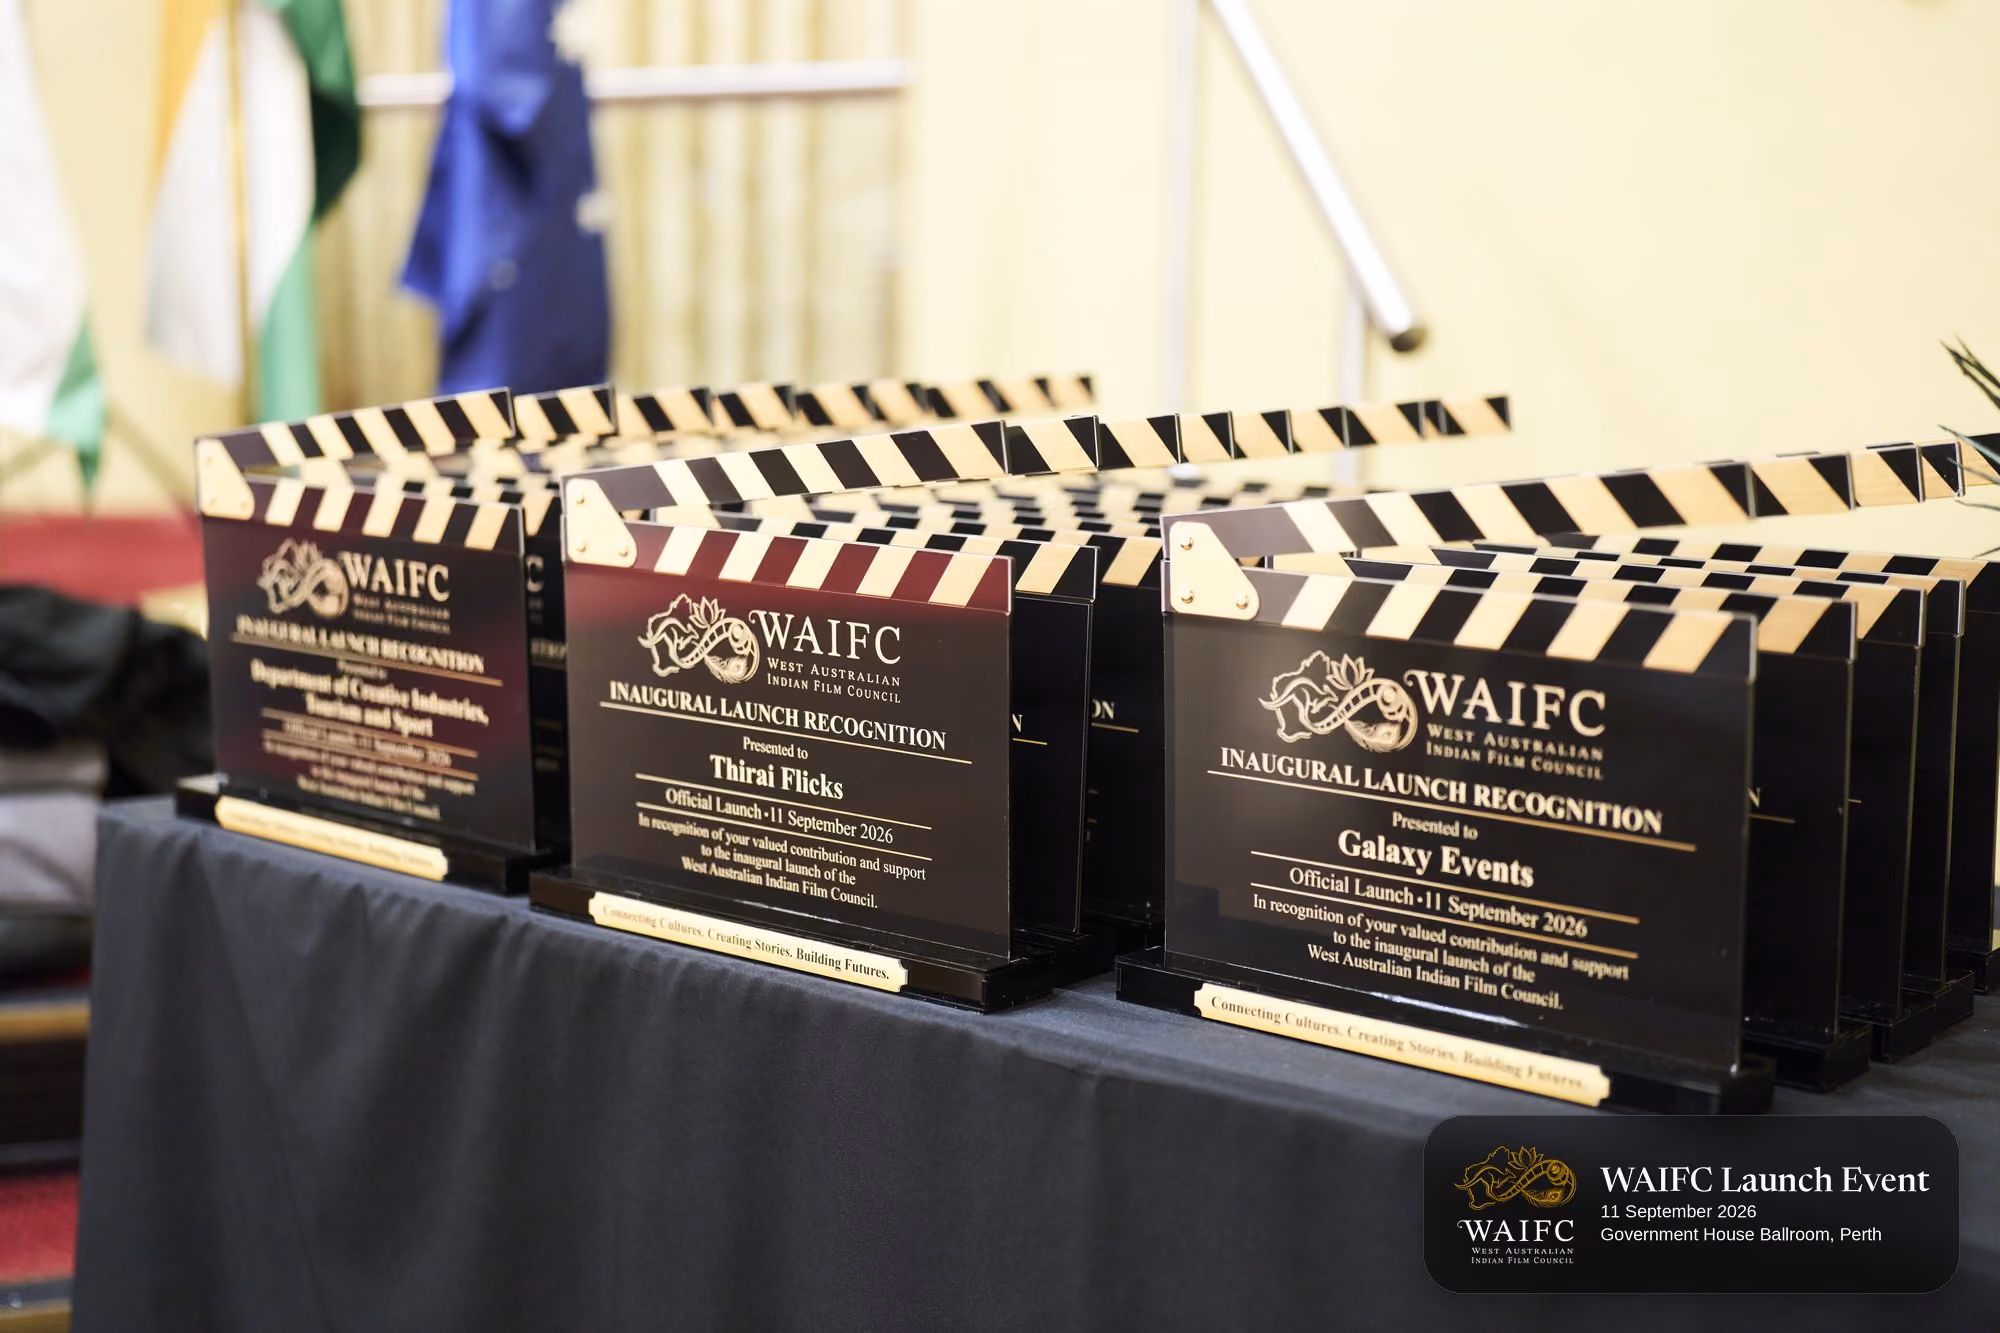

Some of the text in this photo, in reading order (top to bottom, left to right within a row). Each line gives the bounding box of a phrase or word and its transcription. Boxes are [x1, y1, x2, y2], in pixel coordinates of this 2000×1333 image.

[337, 550, 450, 602] WAIFC
[380, 637, 485, 674] RECOGNITION
[748, 609, 901, 665] WAIFC
[767, 657, 901, 687] WEST AUSTRALIAN
[767, 673, 901, 704] INDIAN FILM COUNCIL
[609, 680, 947, 751] INAUGURAL LAUNCH RECOGNITION
[1402, 669, 1607, 737] WAIFC
[742, 736, 809, 760] Presented to
[1426, 723, 1604, 761] WEST AUSTRALIAN
[1426, 741, 1604, 781] INDIAN FILM COUNCIL
[709, 753, 844, 800] Thirai Flicks
[1219, 746, 1664, 835] INAUGURAL LAUNCH RECOGNITION
[665, 787, 713, 811] Official
[788, 811, 857, 837] September
[860, 823, 893, 844] 2026
[1392, 810, 1478, 841] Presented to
[638, 812, 926, 881] In recognition of your valued contribution and support
[700, 844, 856, 885] to the inaugural launch of the
[1337, 828, 1535, 889] Galaxy Events
[681, 855, 878, 909] West Australian Indian Film Council.
[1289, 866, 1349, 895] Official
[1448, 895, 1538, 930] September
[1542, 910, 1588, 939] 2026
[602, 903, 890, 980] Connecting Cultures. Creating Stories. Building Futures.
[1252, 893, 1630, 981] In recognition of your valued contribution and support
[1333, 930, 1536, 984] to the inaugural launch of the
[1307, 943, 1564, 1010] West Australian Indian Film Council.
[1210, 995, 1282, 1025] Connecting
[1285, 1012, 1344, 1038] Cultures.
[1347, 1025, 1405, 1053] Creating
[1462, 1051, 1523, 1079] Building
